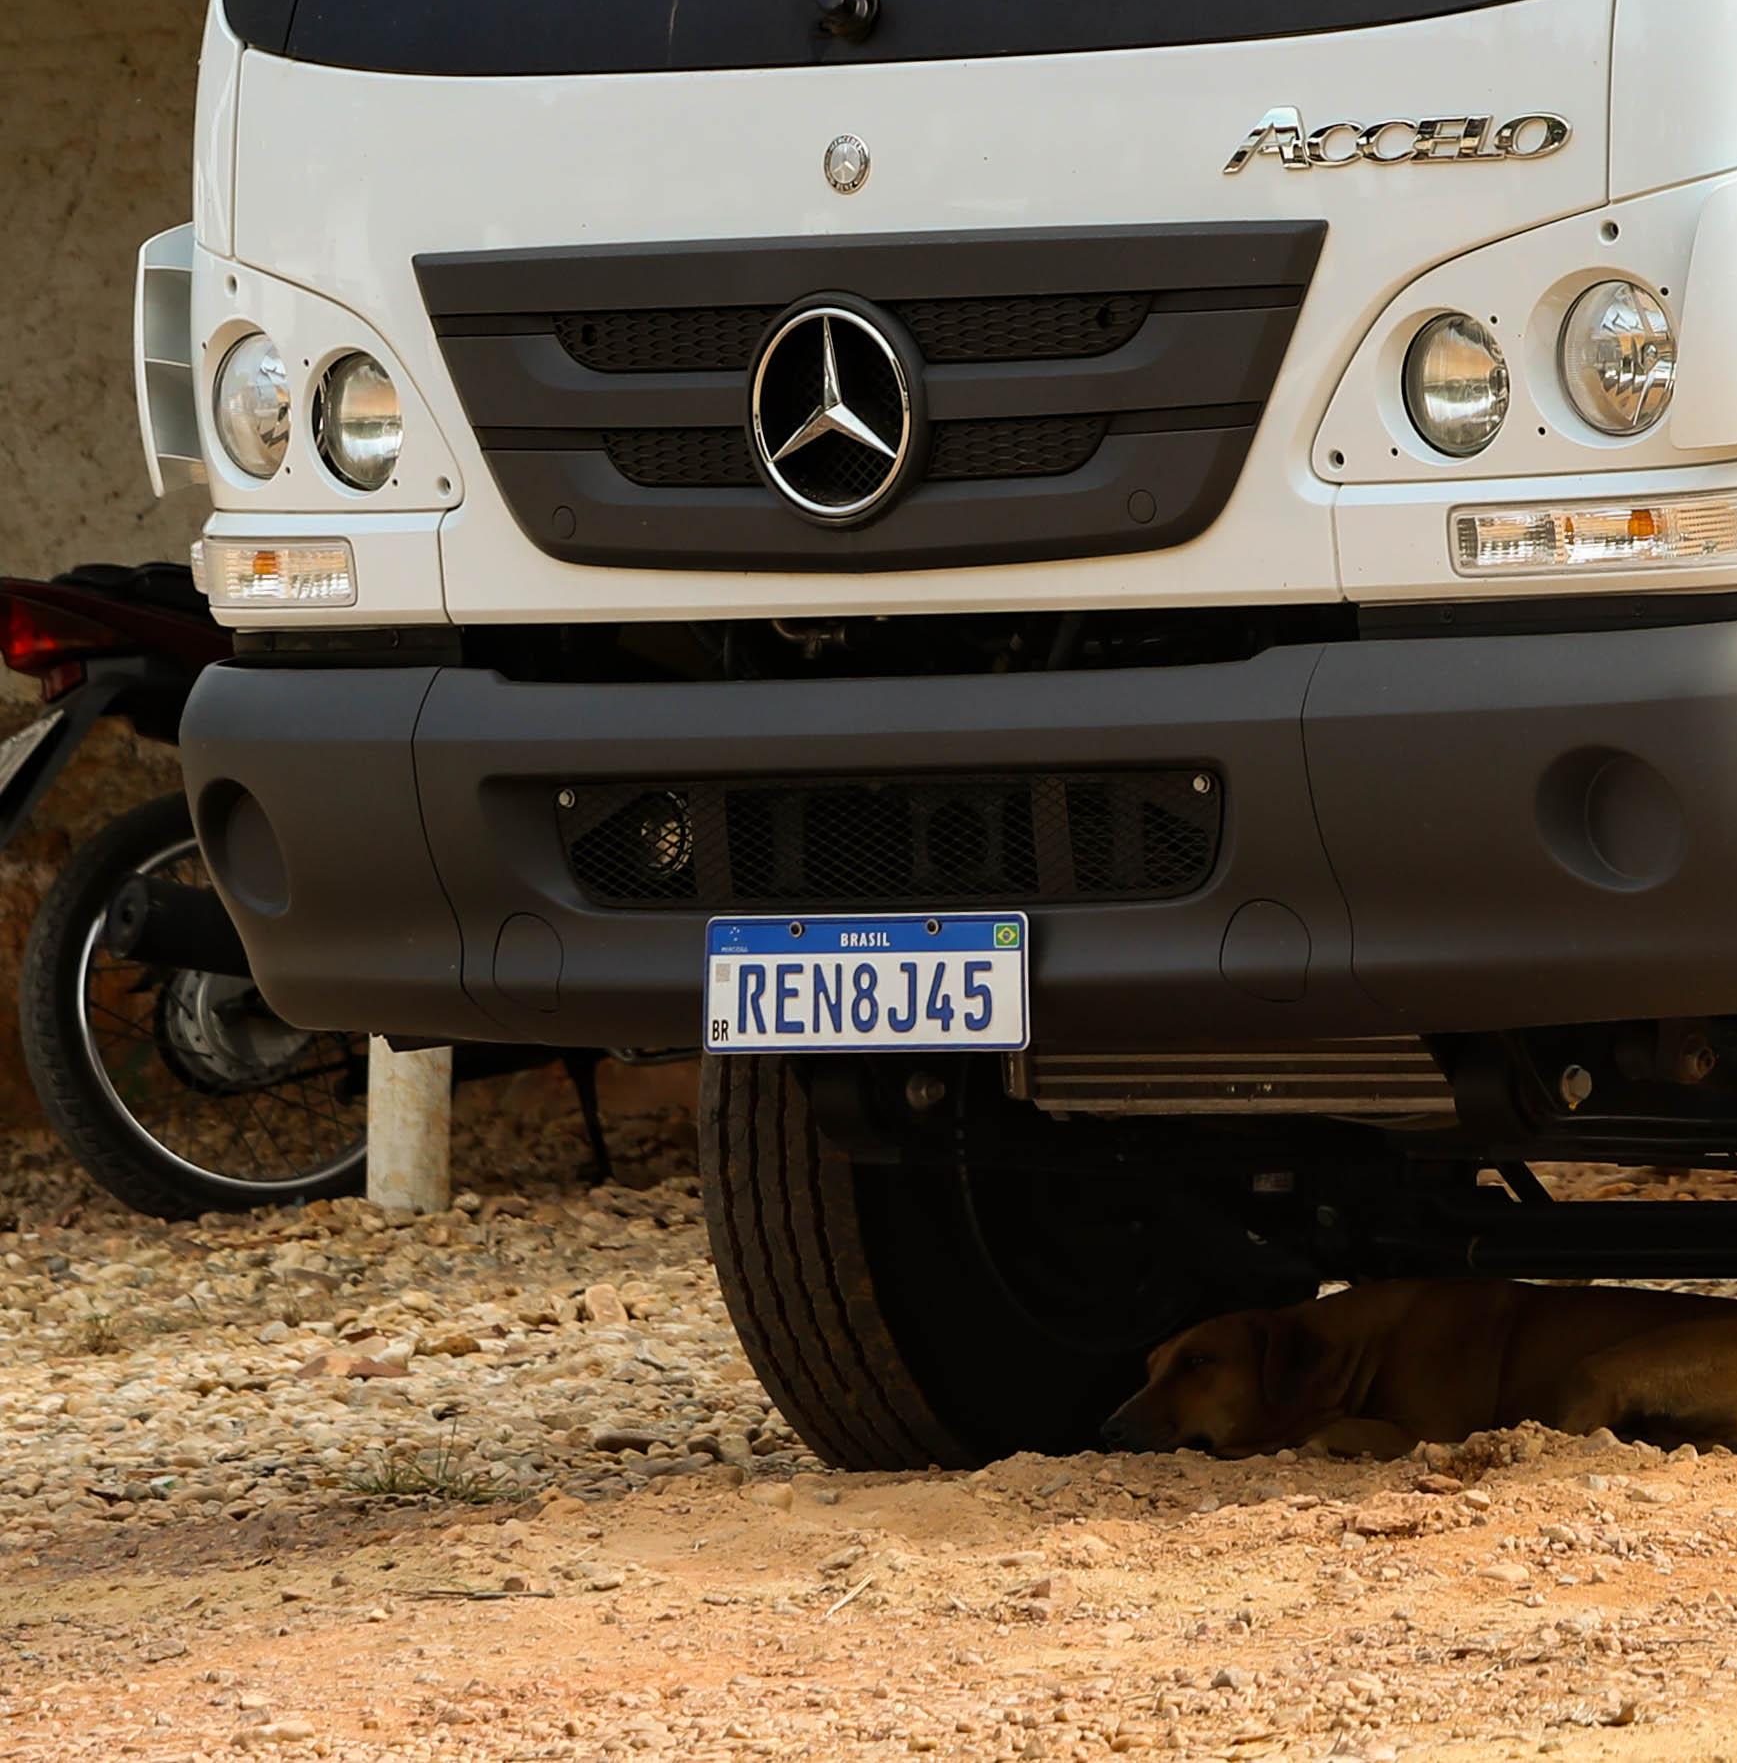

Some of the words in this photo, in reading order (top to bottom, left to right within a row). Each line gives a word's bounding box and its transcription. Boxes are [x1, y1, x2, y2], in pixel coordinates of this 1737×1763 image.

[839, 931, 891, 948] BRASIL
[737, 960, 993, 1035] REN8J45
[711, 1020, 729, 1042] BR
